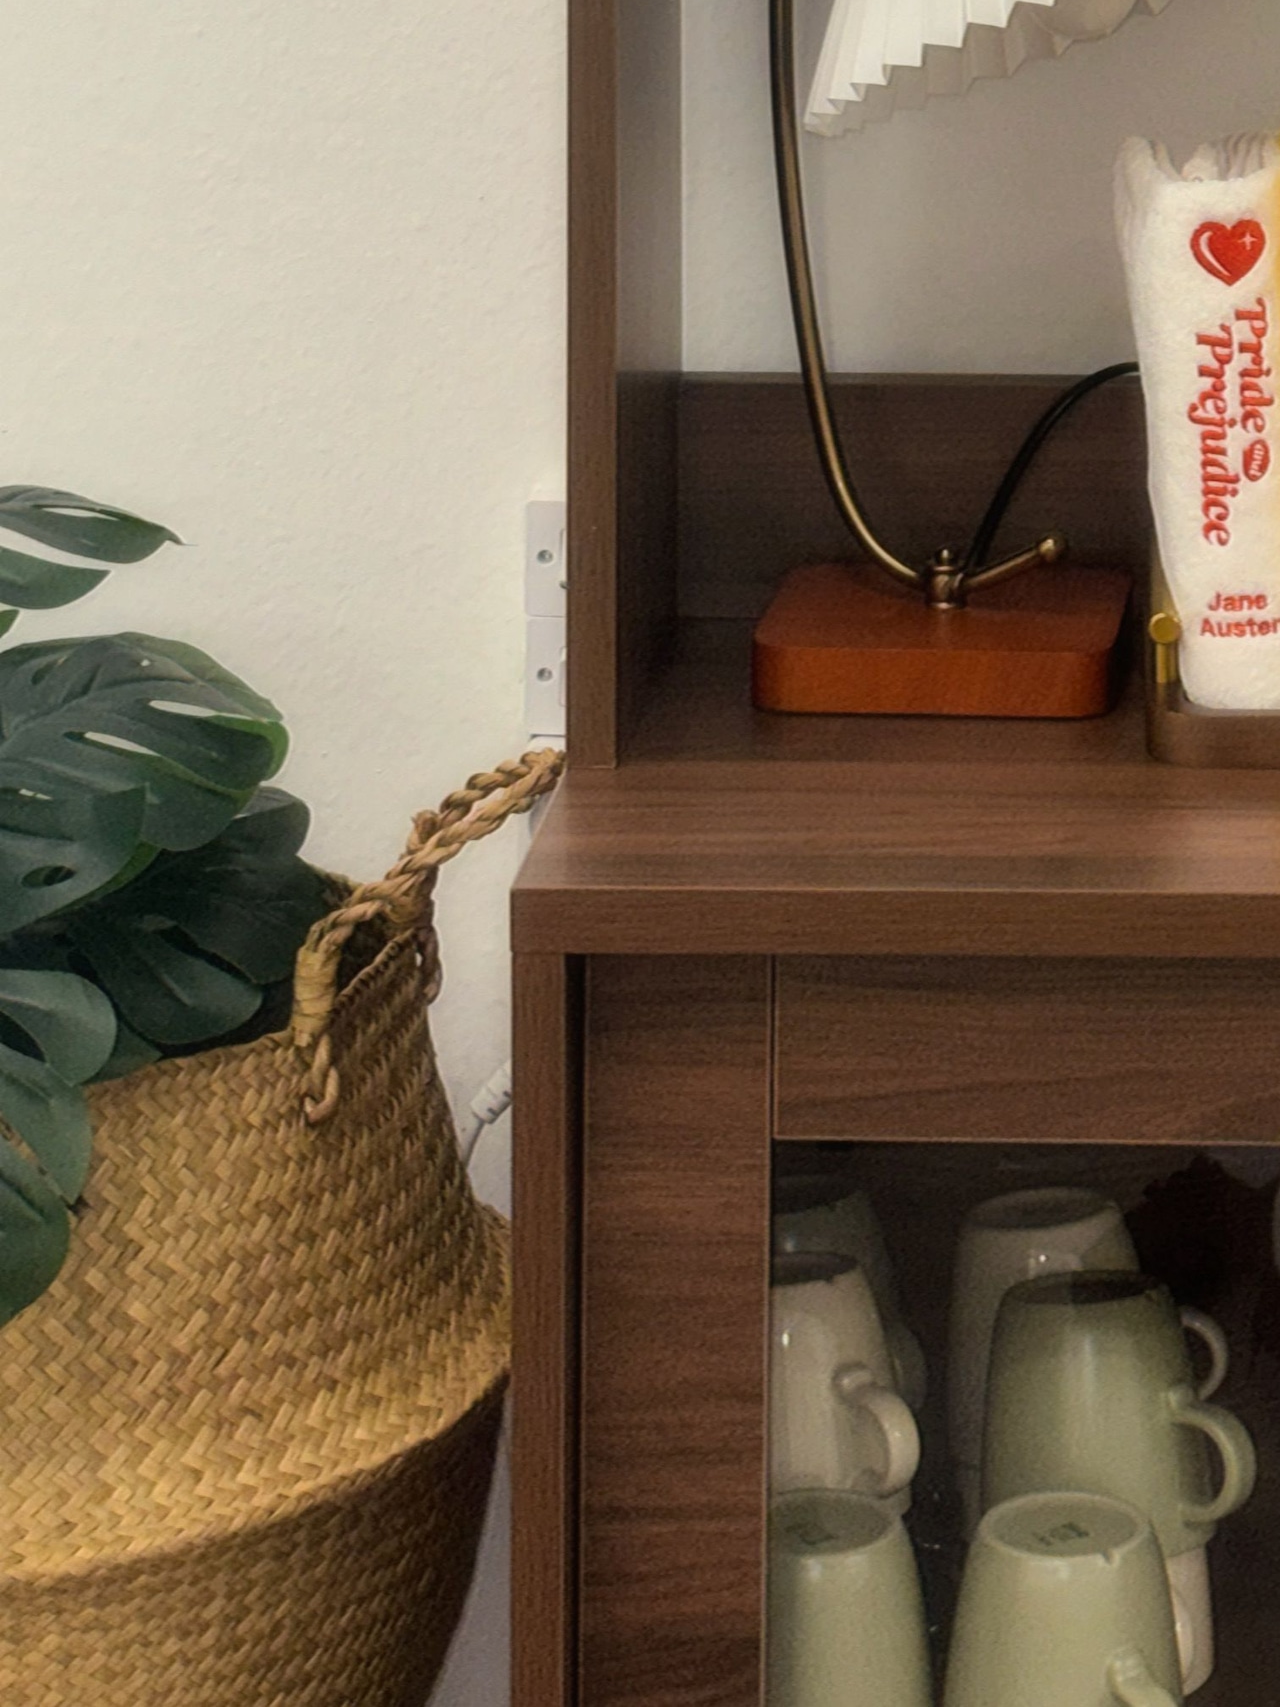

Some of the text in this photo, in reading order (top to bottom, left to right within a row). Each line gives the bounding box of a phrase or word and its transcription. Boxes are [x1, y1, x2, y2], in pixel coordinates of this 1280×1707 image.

[1235, 297, 1275, 434] Pride
[1187, 323, 1241, 547] Prejudice
[1208, 592, 1268, 613] Jane
